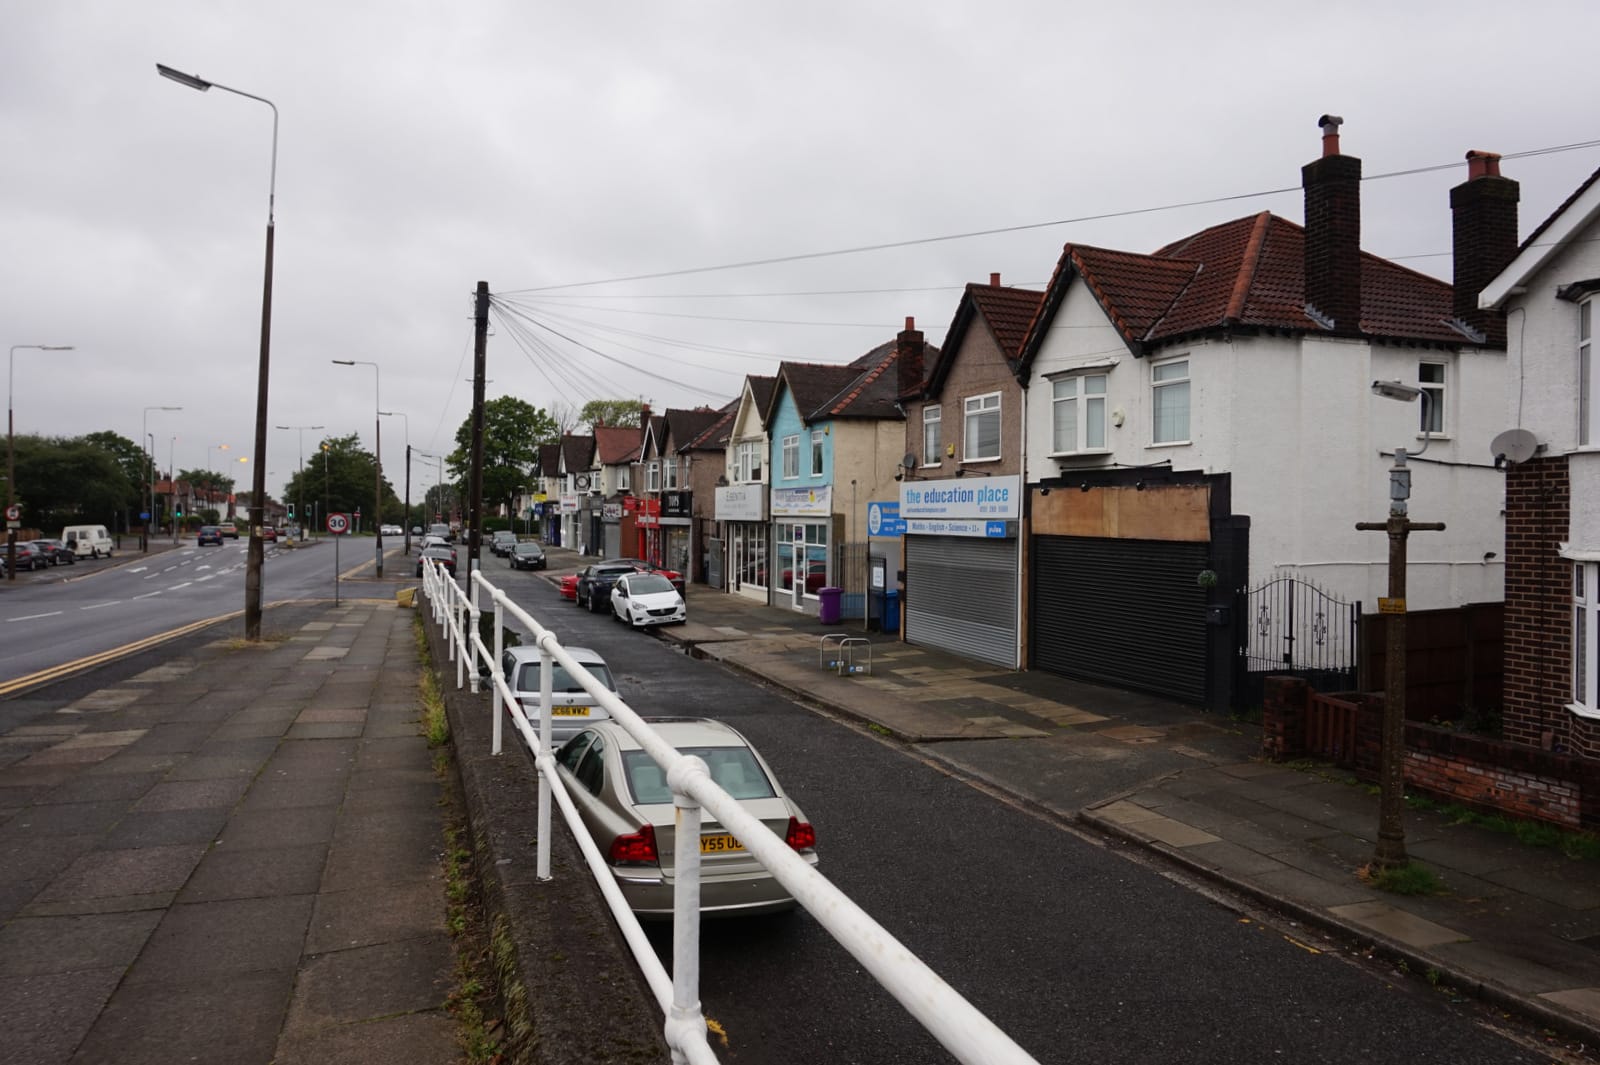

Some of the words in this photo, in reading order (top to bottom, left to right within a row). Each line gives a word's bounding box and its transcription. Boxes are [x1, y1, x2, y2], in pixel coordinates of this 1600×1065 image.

[906, 489, 921, 504] the
[924, 486, 974, 504] education
[977, 485, 1009, 505] place
[330, 518, 346, 528] 30
[928, 522, 944, 532] English
[948, 523, 968, 532] Science
[701, 838, 724, 851] Y55
